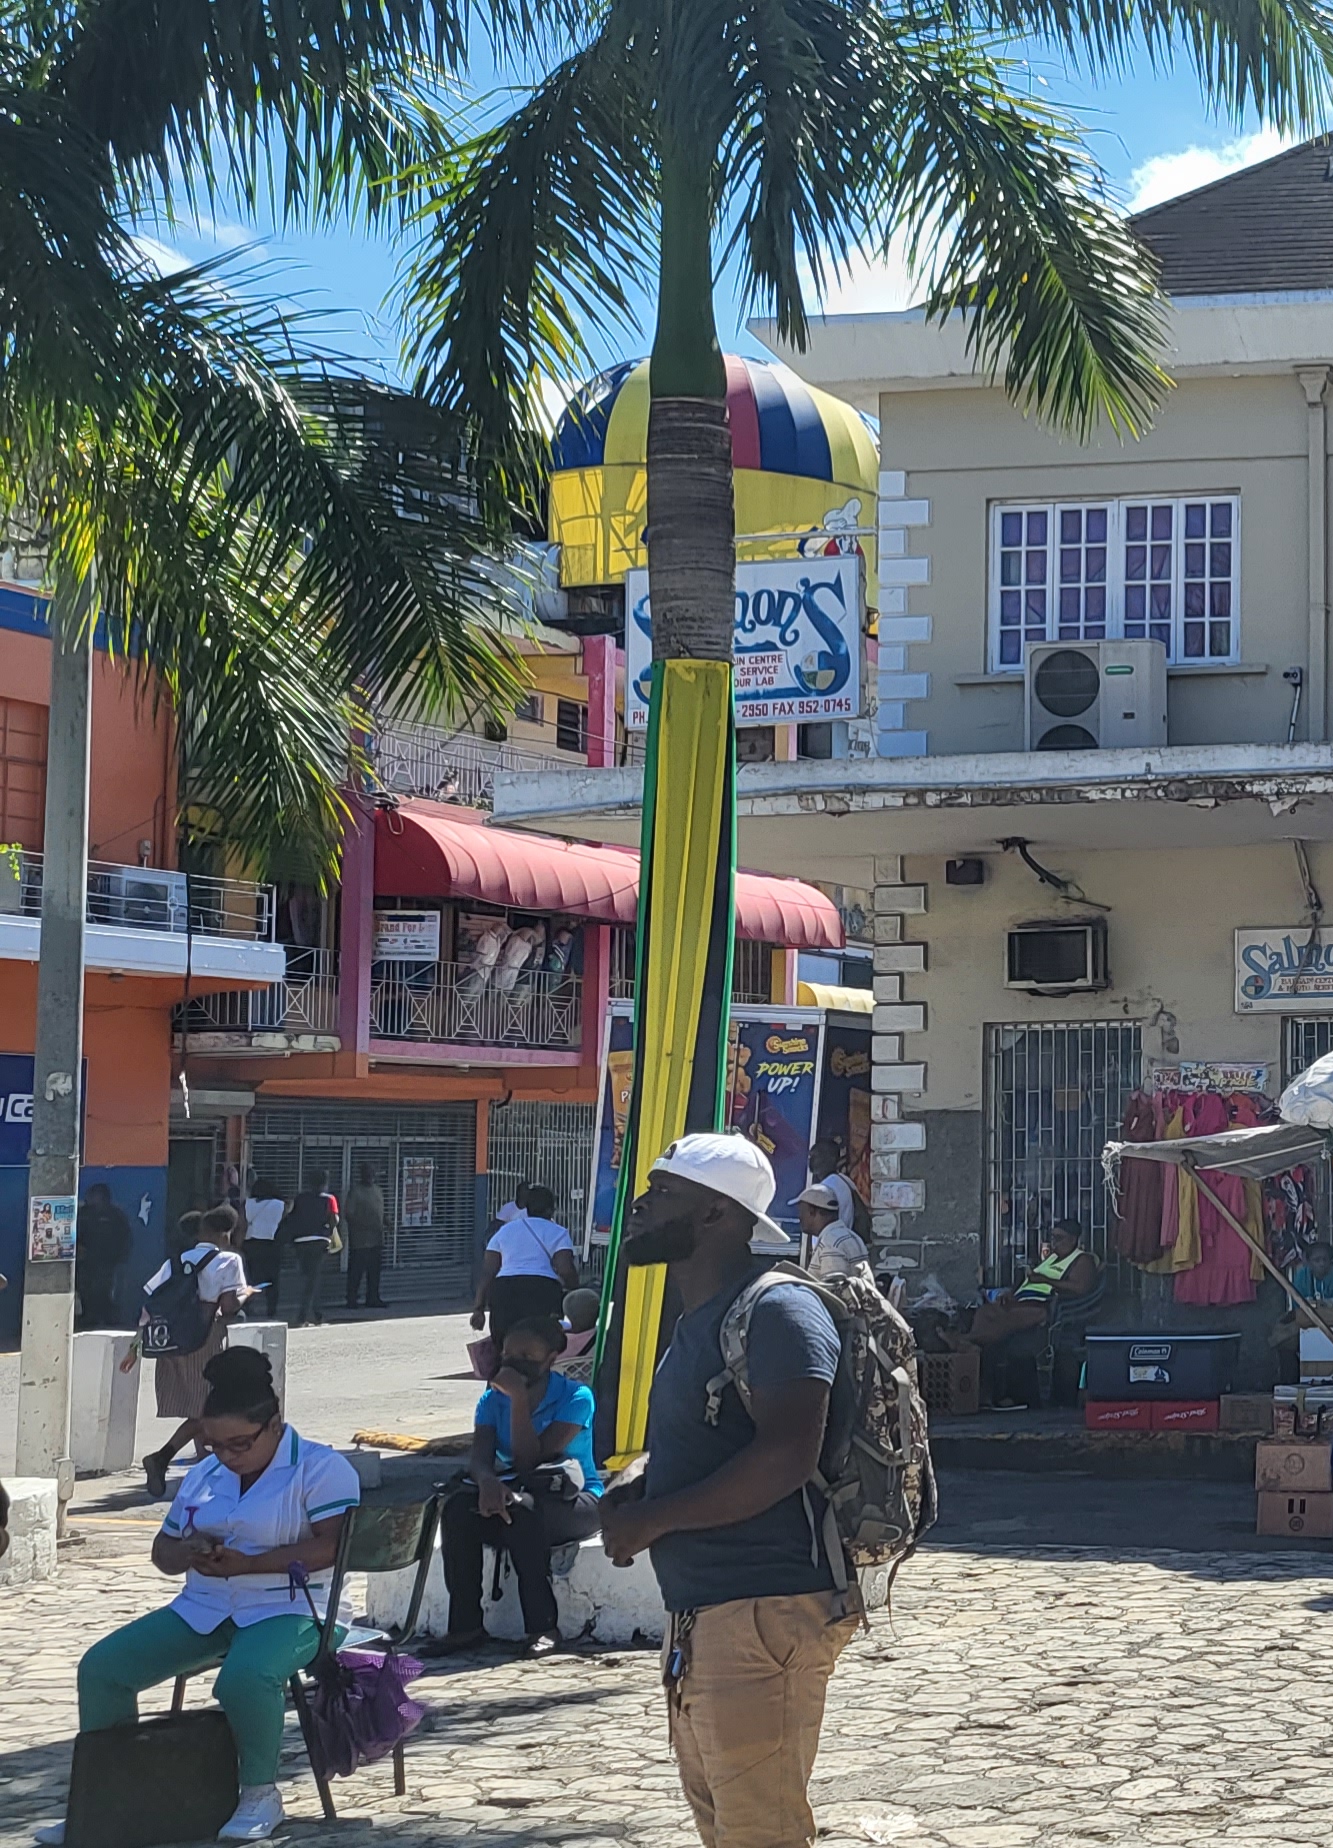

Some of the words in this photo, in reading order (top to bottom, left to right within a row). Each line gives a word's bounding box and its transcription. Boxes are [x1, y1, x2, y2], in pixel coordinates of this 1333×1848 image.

[750, 654, 784, 665] CENTRE
[739, 665, 779, 675] SERVICE
[755, 676, 775, 686] LAB
[736, 703, 769, 718] -2950
[771, 701, 795, 716] FAX
[797, 698, 851, 714] 952-0745
[755, 1061, 814, 1078] POWER
[767, 1077, 800, 1095] UP!
